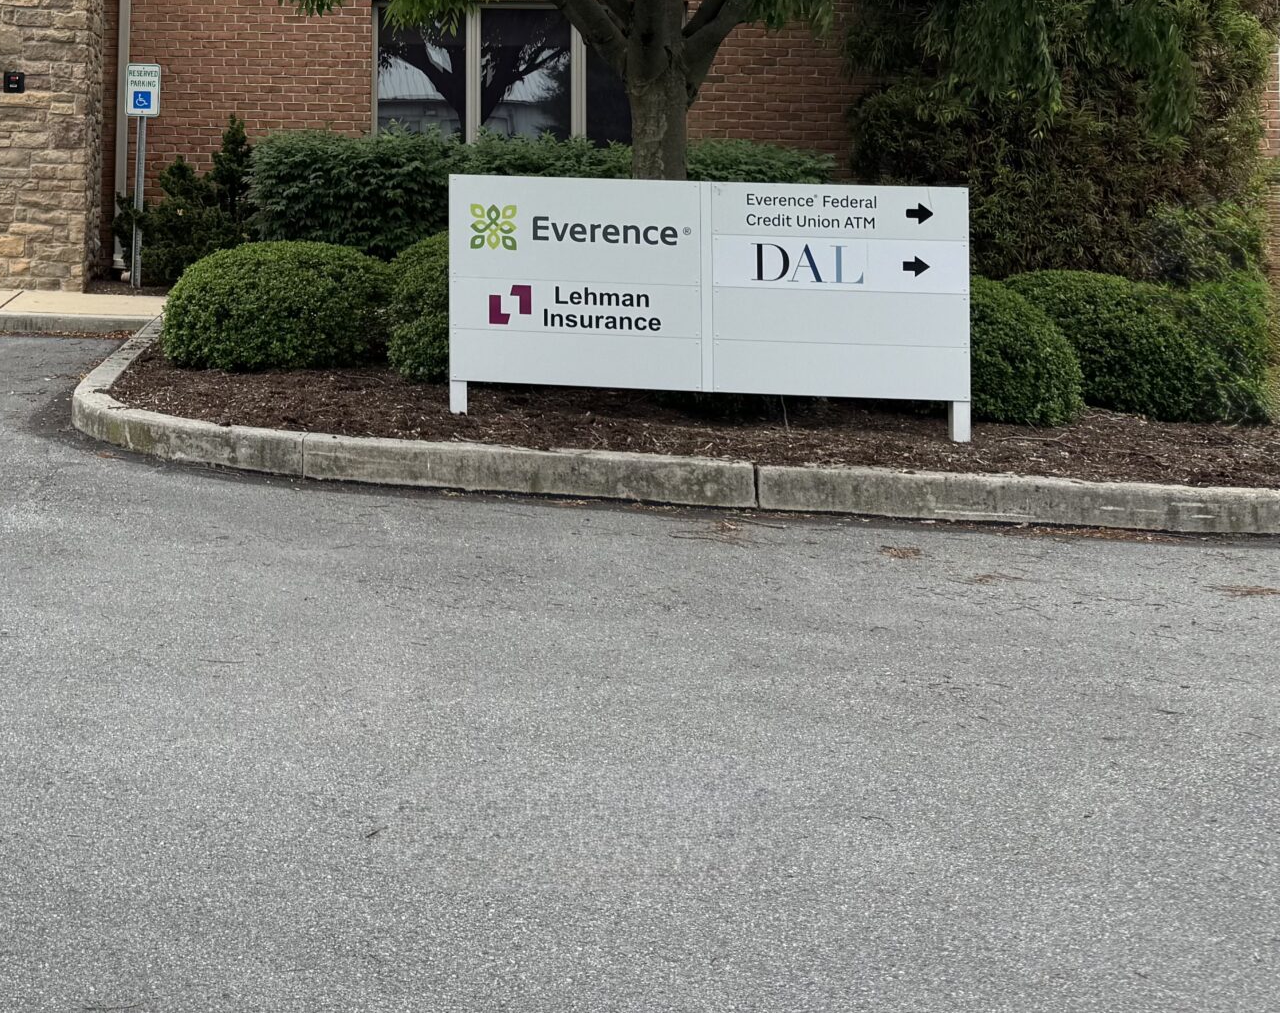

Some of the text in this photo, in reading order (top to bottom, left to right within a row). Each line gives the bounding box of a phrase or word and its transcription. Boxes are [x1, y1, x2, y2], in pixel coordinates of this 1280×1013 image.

[128, 70, 158, 78] RESERVED
[130, 80, 157, 88] PARKING
[822, 195, 877, 209] Federal
[746, 213, 876, 230] Credit Union ATM
[750, 242, 864, 285] DAL
[555, 285, 650, 308] Lehman
[543, 308, 662, 332] Insurance
